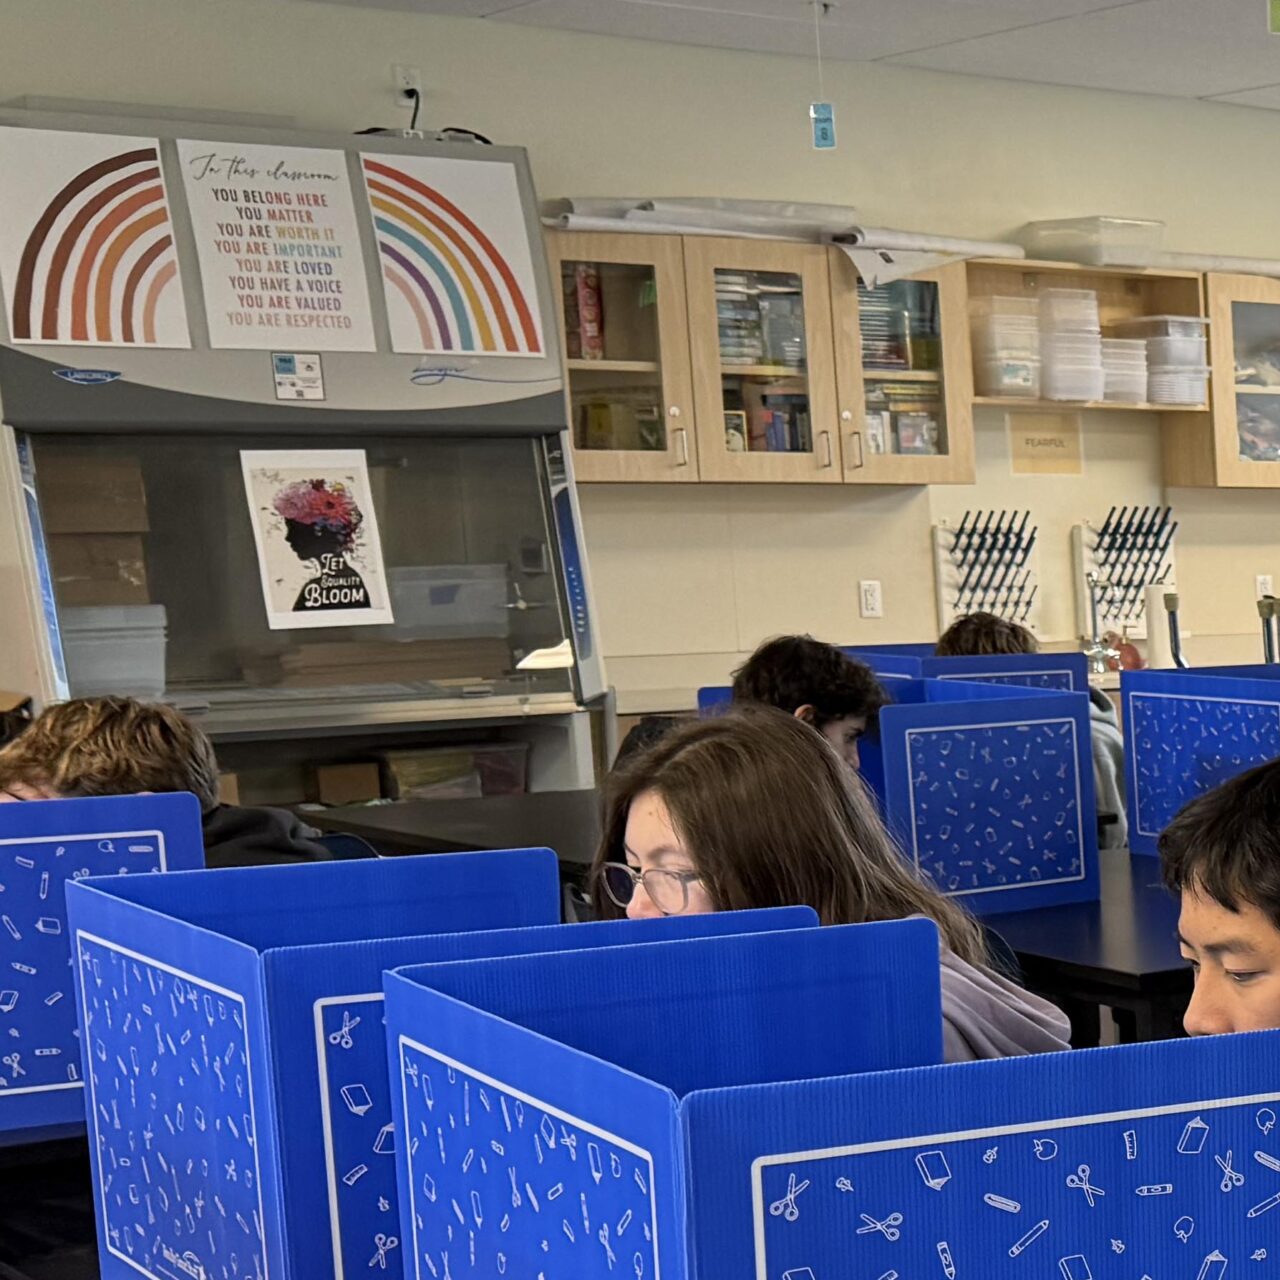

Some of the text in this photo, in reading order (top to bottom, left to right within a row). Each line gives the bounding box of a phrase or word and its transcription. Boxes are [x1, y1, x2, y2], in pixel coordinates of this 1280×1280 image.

[189, 153, 338, 181] In this classroom
[212, 188, 328, 207] YOU BELONG HERE
[236, 206, 314, 224] YOU MATTER
[217, 222, 335, 241] YOU ARE WORTH IT
[214, 240, 343, 258] YOU ARE IMPORTANT
[236, 258, 333, 275] YOU ARE LOVED
[229, 276, 343, 294] YOU HAVE A VOICE
[238, 294, 341, 311] YOU ARE VALUED
[227, 312, 352, 329] YOU ARE RESPECTED
[1024, 438, 1066, 449] FEARFUL
